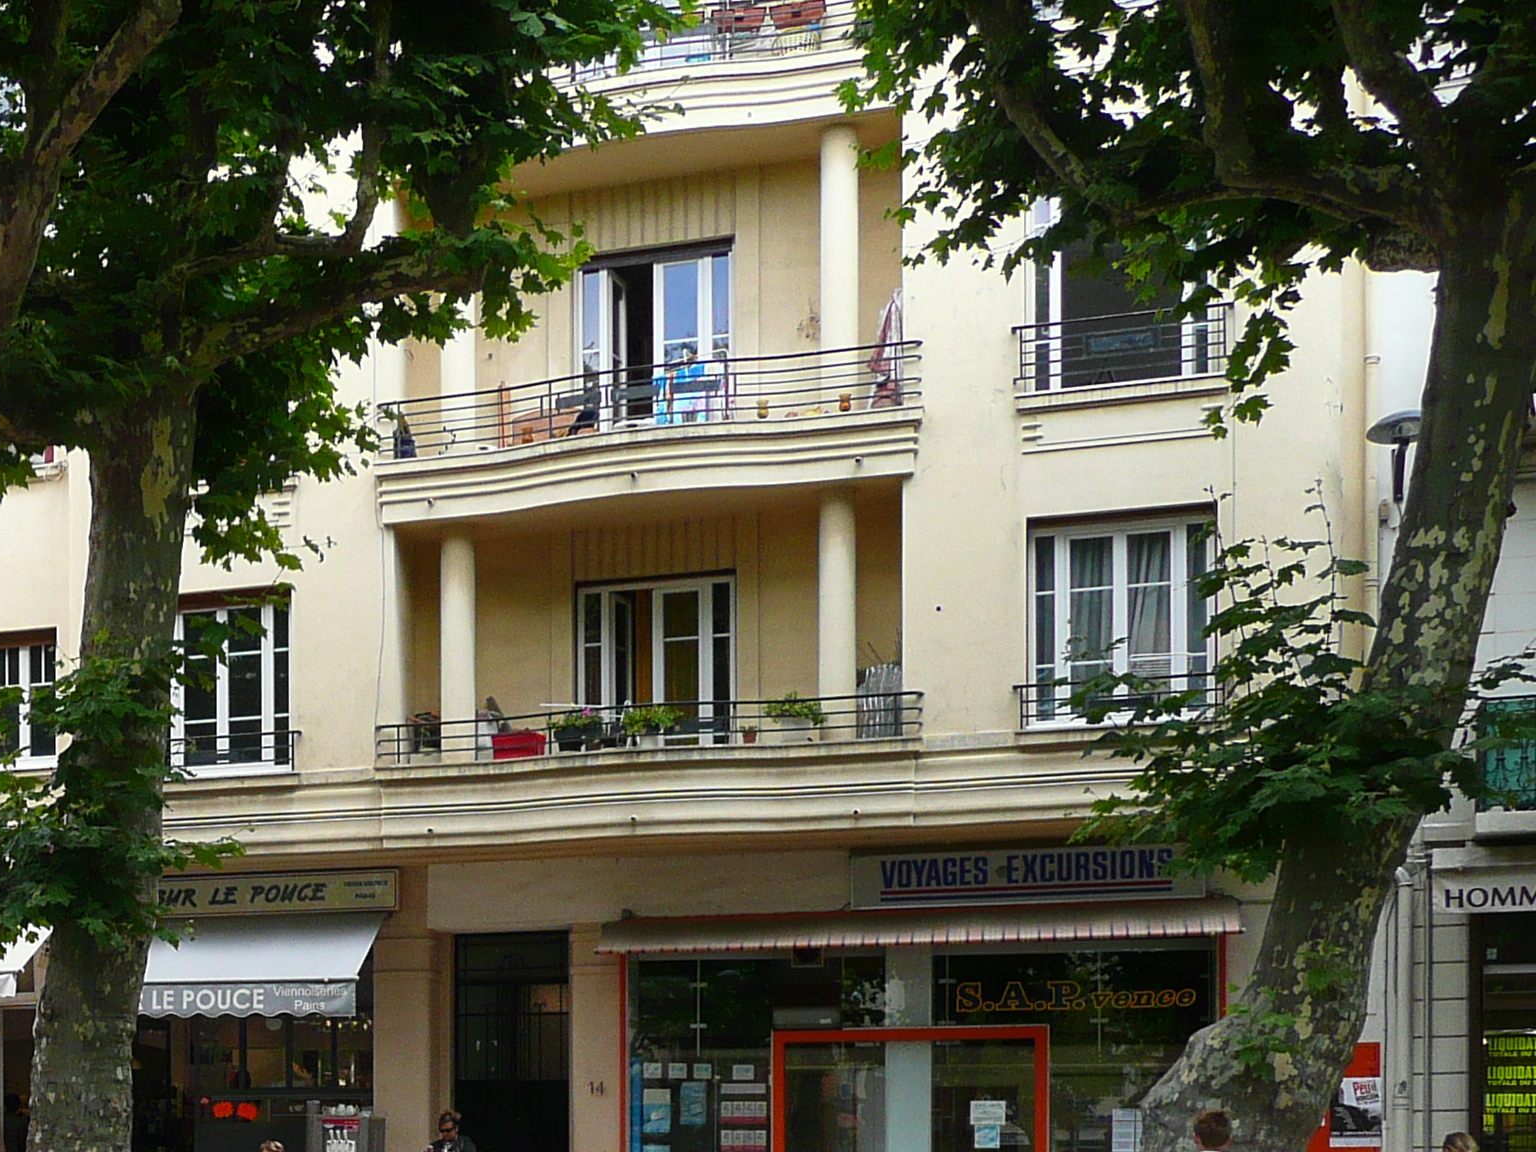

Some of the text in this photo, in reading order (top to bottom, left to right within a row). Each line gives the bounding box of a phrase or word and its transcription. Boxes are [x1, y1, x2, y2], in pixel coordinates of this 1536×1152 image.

[881, 848, 1174, 889] VOYAGES EXCURSIONS
[209, 886, 238, 906] LE
[250, 883, 328, 904] POUCE
[273, 984, 347, 997] Viennoiseries
[152, 990, 174, 1010] LE
[183, 989, 264, 1010] POUCE
[294, 1000, 325, 1011] Pains
[588, 1081, 605, 1095] 14
